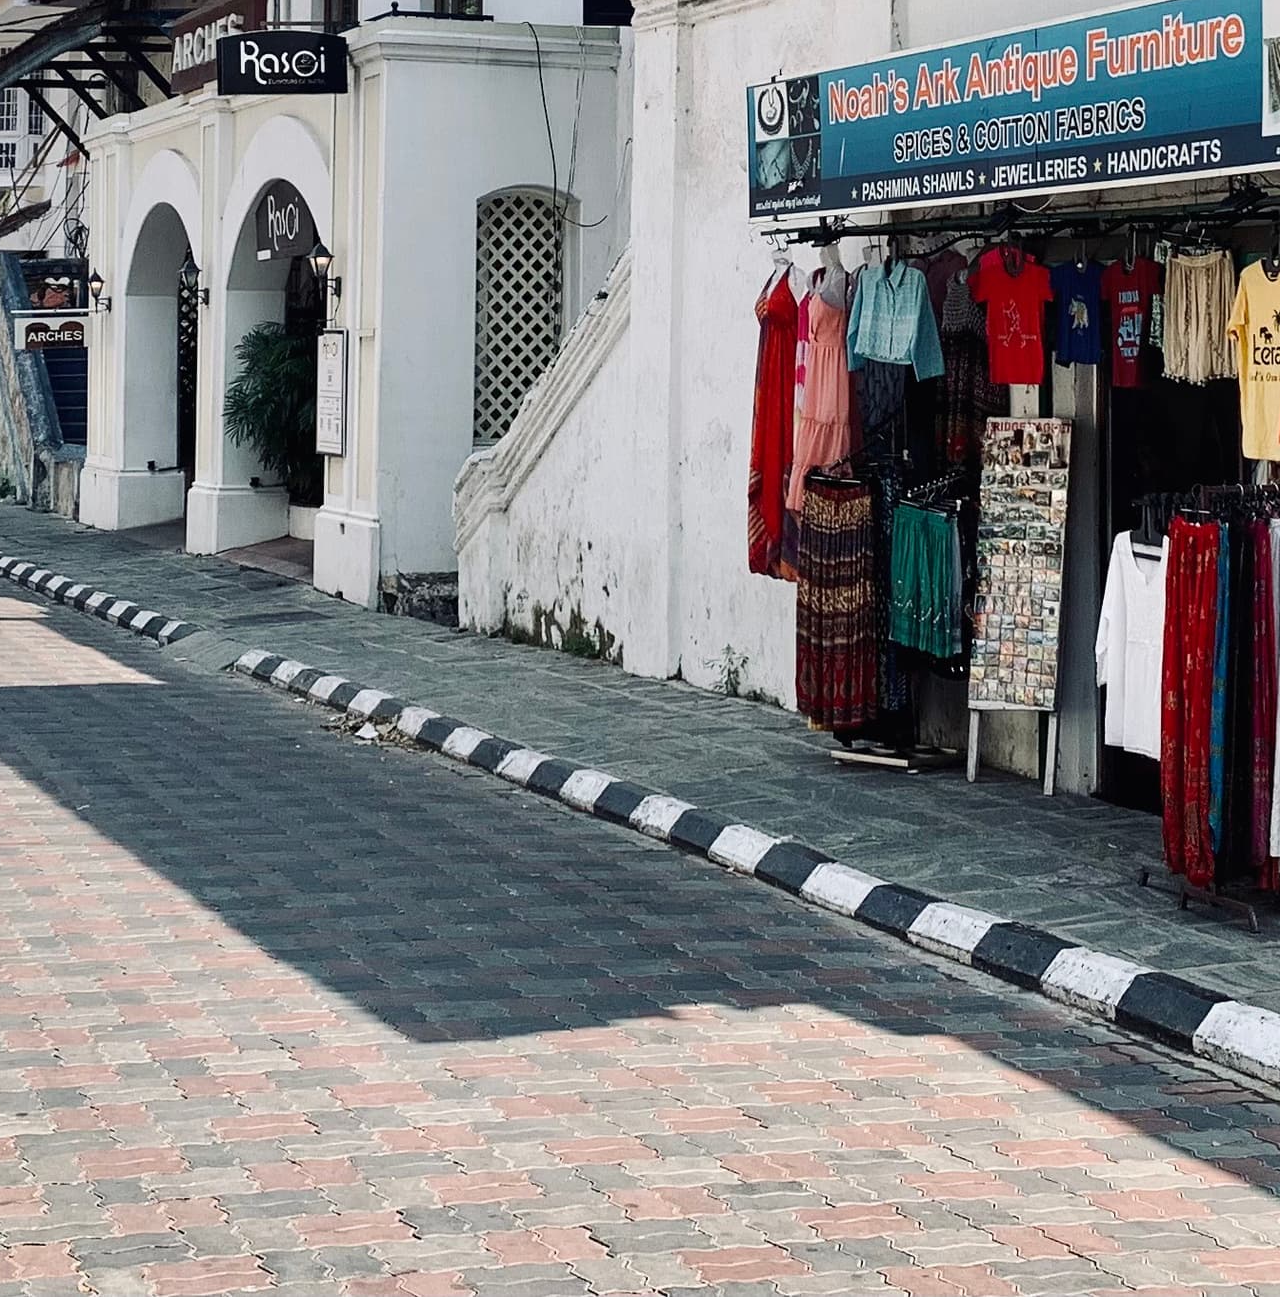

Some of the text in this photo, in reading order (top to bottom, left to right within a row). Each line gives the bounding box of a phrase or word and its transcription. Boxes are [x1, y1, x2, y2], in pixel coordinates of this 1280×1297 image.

[240, 40, 325, 85] Rasoi
[829, 11, 1245, 125] Noah's Ark Antique Furniture
[893, 97, 1145, 163] SPICES & COTTON FABRICS
[991, 156, 1087, 188] JEWELLERIES
[1107, 139, 1221, 175] HANDICRAFTS
[862, 170, 974, 201] PASHMINA SHAWLS
[267, 195, 299, 251] Rasoi
[27, 330, 83, 343] ARCHES
